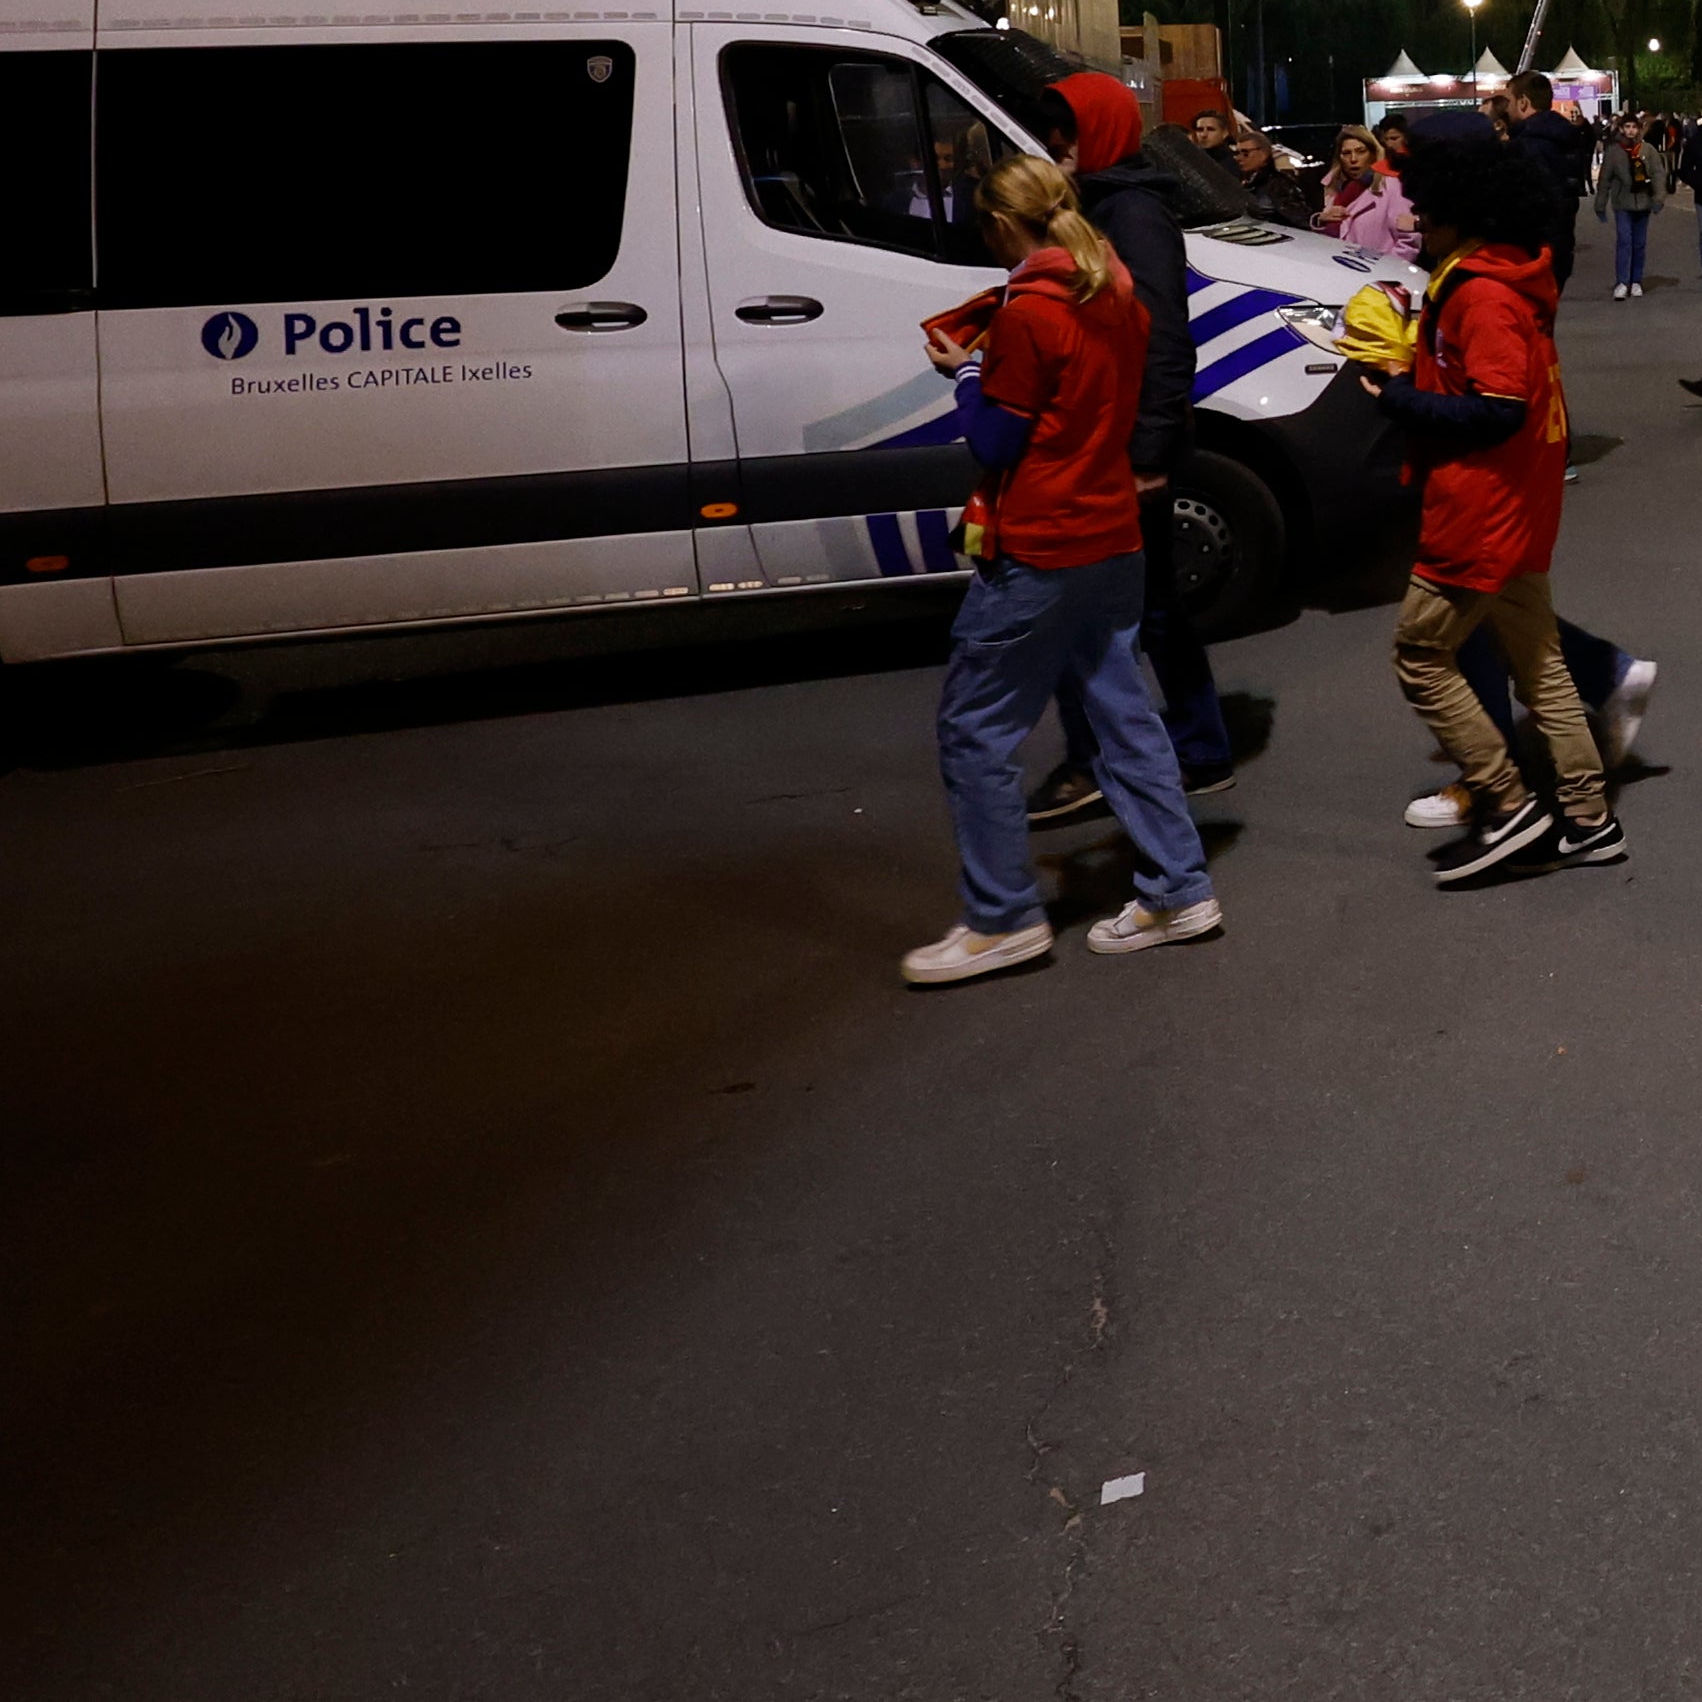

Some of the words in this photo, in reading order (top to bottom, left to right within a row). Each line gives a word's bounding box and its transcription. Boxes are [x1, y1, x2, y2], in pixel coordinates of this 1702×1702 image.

[283, 306, 462, 356] Police
[231, 373, 340, 395] Bruxelles
[346, 365, 454, 389] CAPITALE
[460, 361, 533, 382] Ixelles
